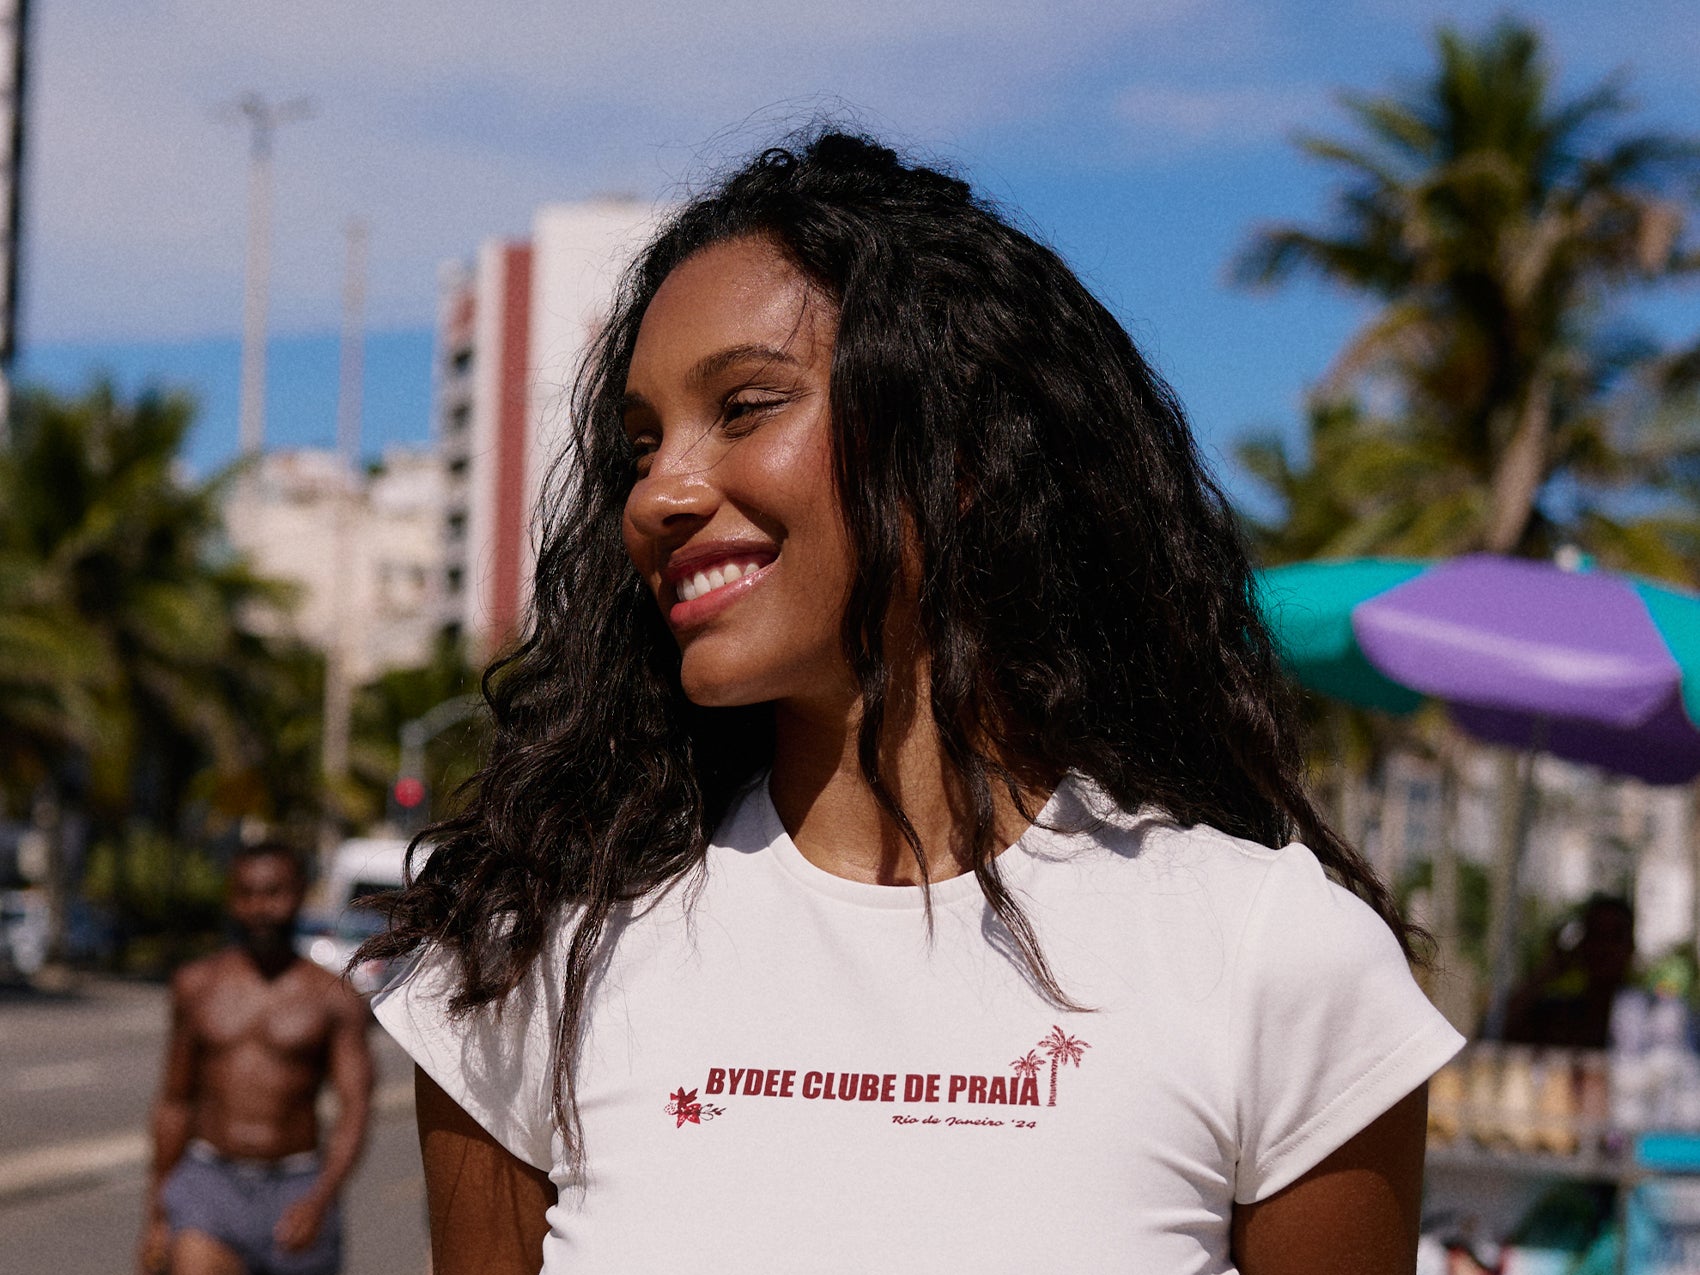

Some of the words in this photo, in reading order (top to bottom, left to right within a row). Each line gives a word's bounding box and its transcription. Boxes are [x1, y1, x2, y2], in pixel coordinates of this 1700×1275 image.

[705, 1068, 797, 1098] BYDEE
[801, 1070, 897, 1103] CLUBE
[903, 1074, 941, 1103] DE
[947, 1074, 1040, 1106] PRAIA
[891, 1115, 920, 1125] Rio
[921, 1115, 942, 1125] de
[944, 1116, 1005, 1127] Janeiro
[1011, 1119, 1037, 1129] '24
